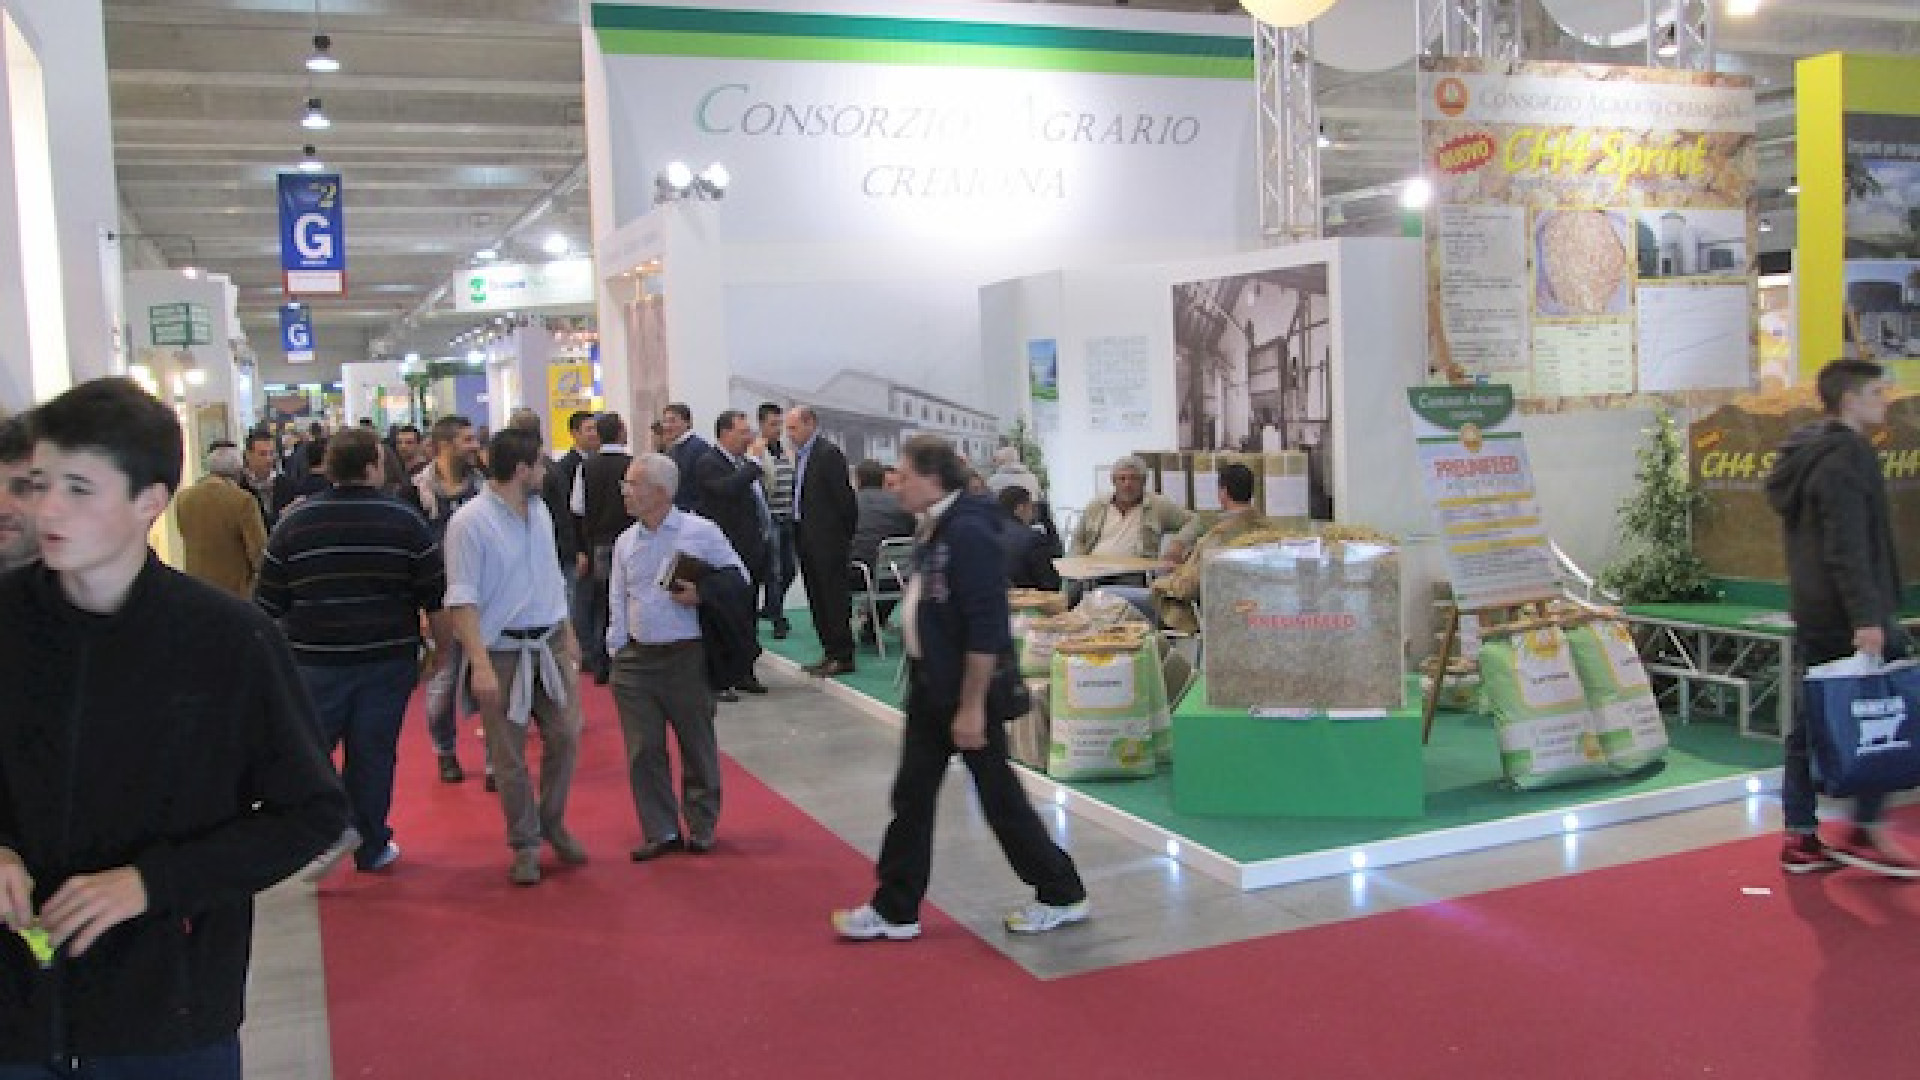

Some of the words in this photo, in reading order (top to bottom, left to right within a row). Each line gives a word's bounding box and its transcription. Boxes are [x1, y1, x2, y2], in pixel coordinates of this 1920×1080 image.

[1504, 129, 1591, 174] CH4
[1597, 131, 1708, 192] Sprint
[860, 165, 1067, 199] CREMONA
[293, 212, 334, 259] G
[286, 323, 310, 346] G
[1701, 450, 1756, 479] CH4
